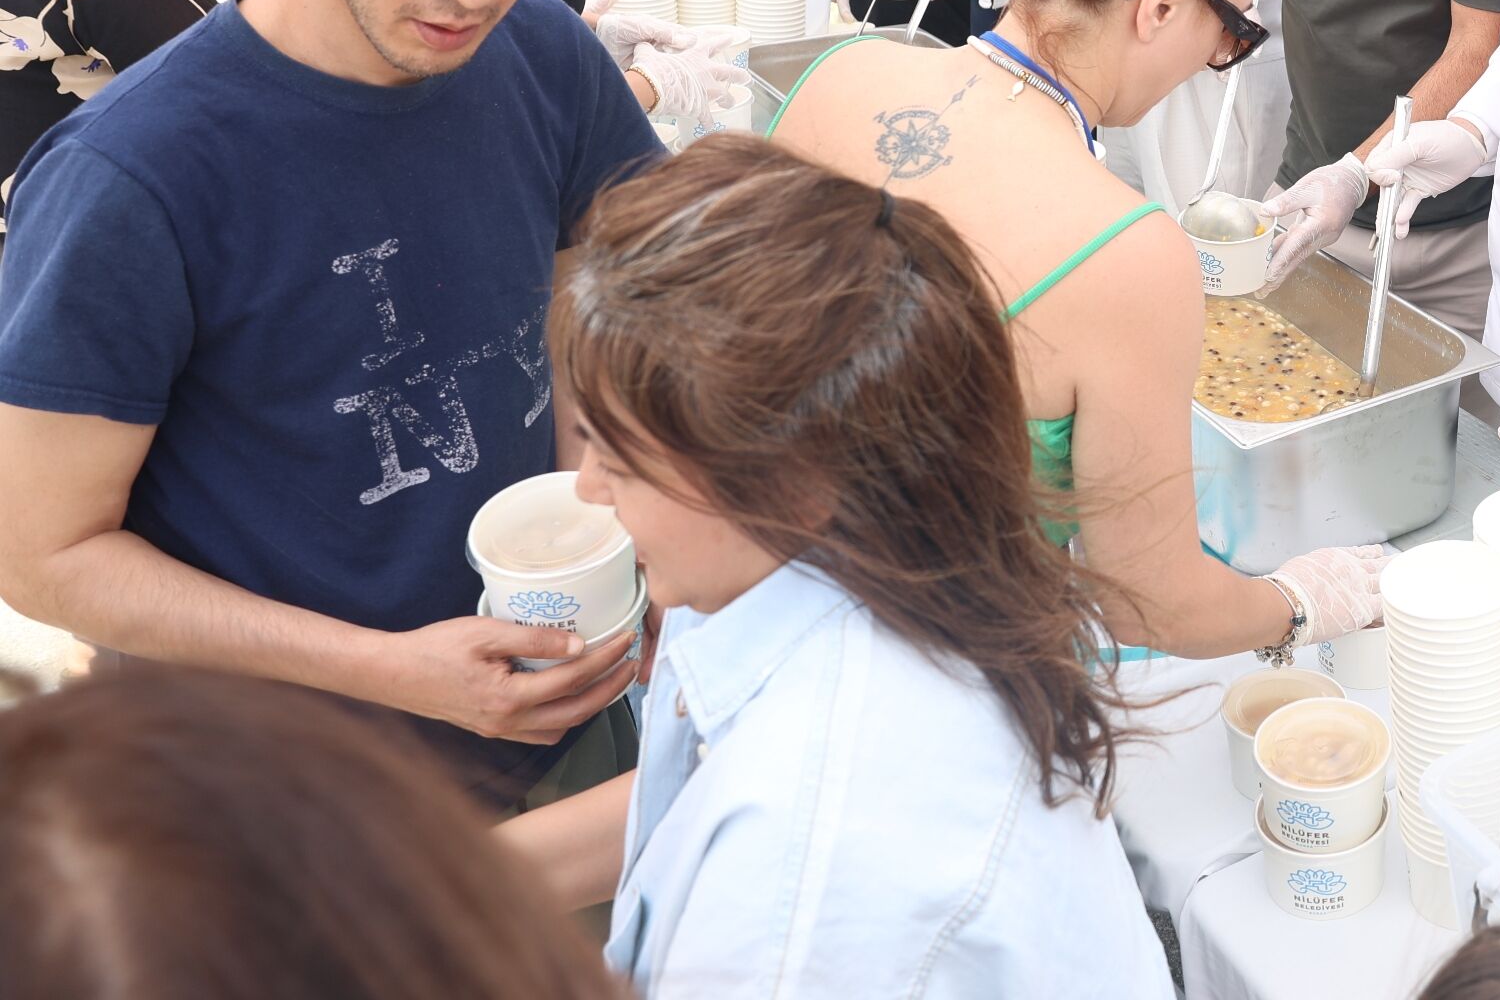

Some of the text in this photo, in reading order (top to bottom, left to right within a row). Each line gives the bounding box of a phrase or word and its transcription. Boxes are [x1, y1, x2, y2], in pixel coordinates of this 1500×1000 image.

[1281, 822, 1330, 839] NİLÜFER
[1281, 830, 1330, 845] BELEDİYESİ
[1293, 894, 1345, 904] NİLÜFER
[1294, 902, 1345, 911] BELEDİYESİ
